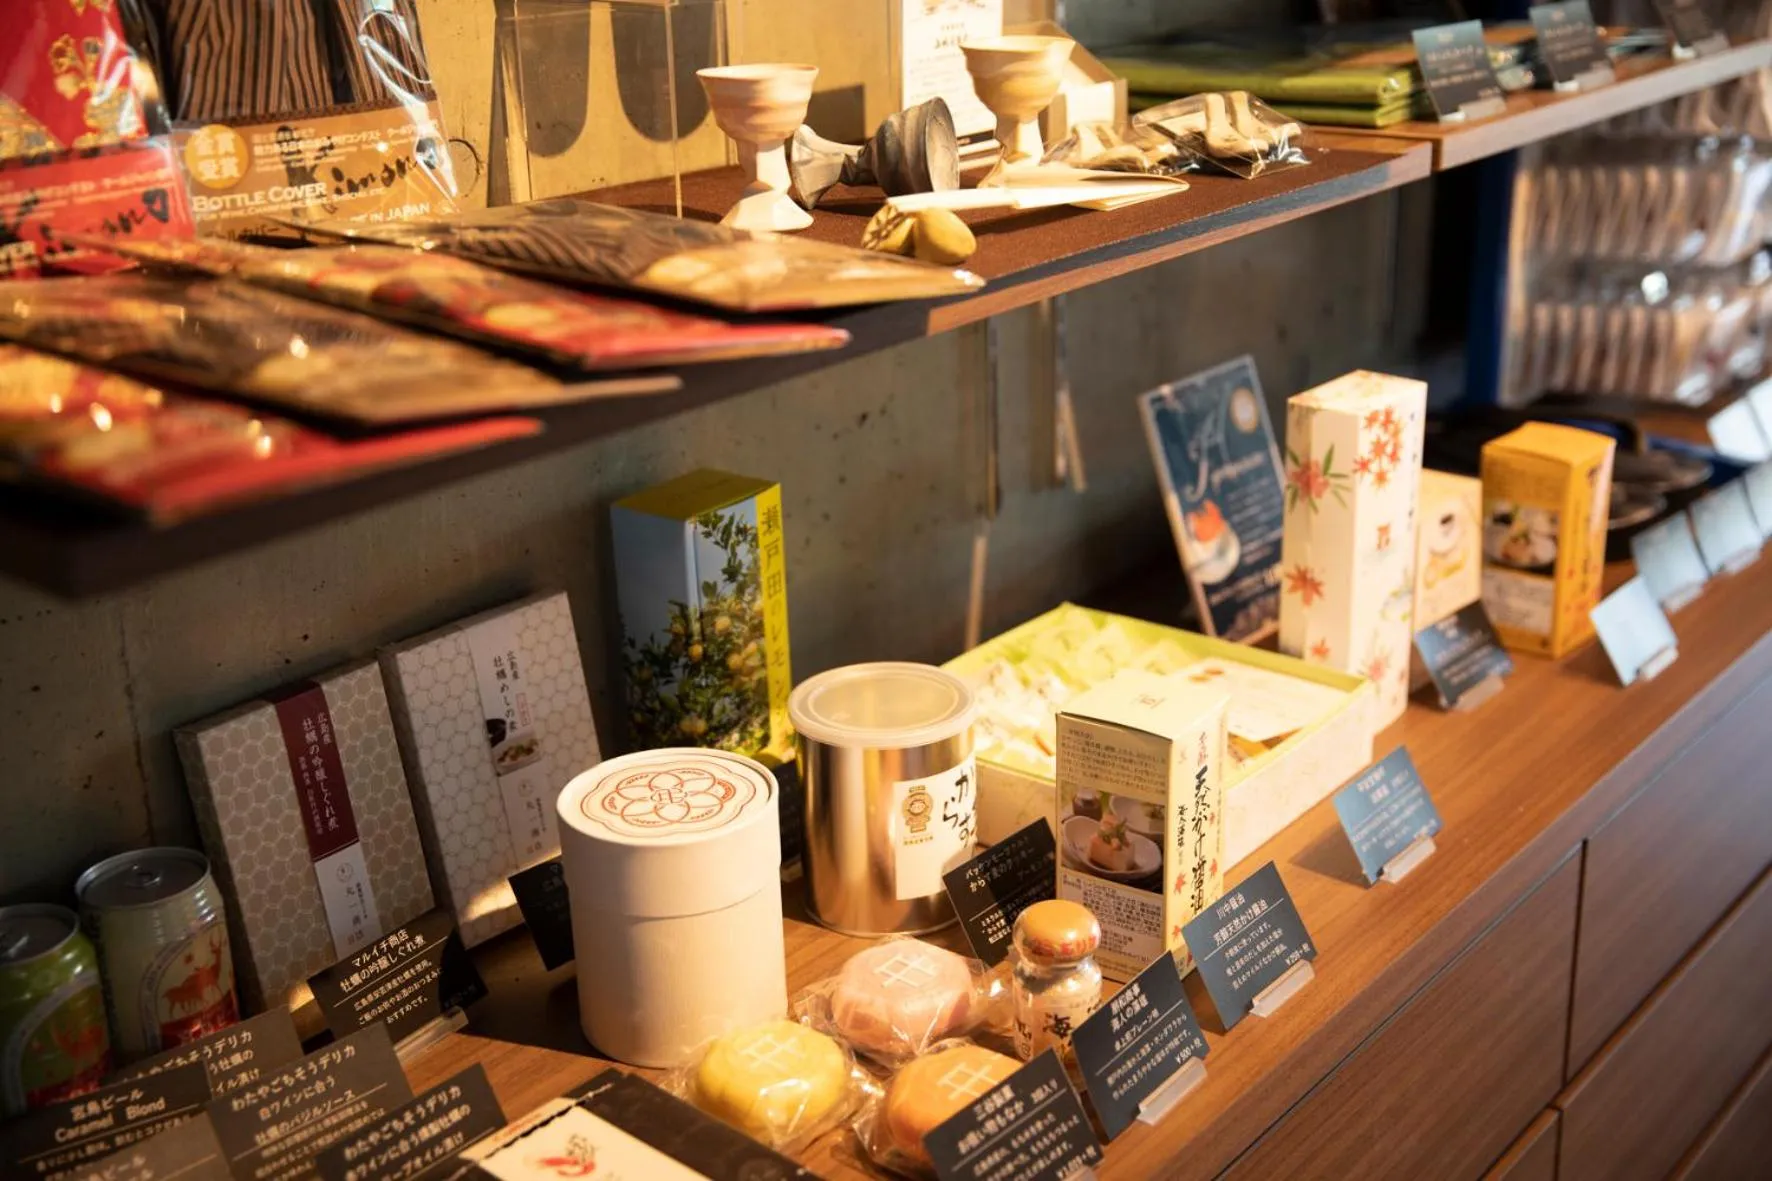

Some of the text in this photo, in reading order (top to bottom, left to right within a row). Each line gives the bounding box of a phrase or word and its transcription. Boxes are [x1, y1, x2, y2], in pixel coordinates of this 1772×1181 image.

[192, 182, 327, 213] BOTTLE COVER
[386, 203, 431, 222] JAPAN
[340, 934, 427, 993] 牡蠣の吟醸しぐれ煮
[351, 928, 409, 967] マルイチ商店
[386, 996, 429, 1025] おすすめです。
[231, 1044, 356, 1112] わたやごちそうデリカ
[54, 1098, 167, 1143] Caramel Blond
[344, 1085, 462, 1161] わたやごちそうデリカ
